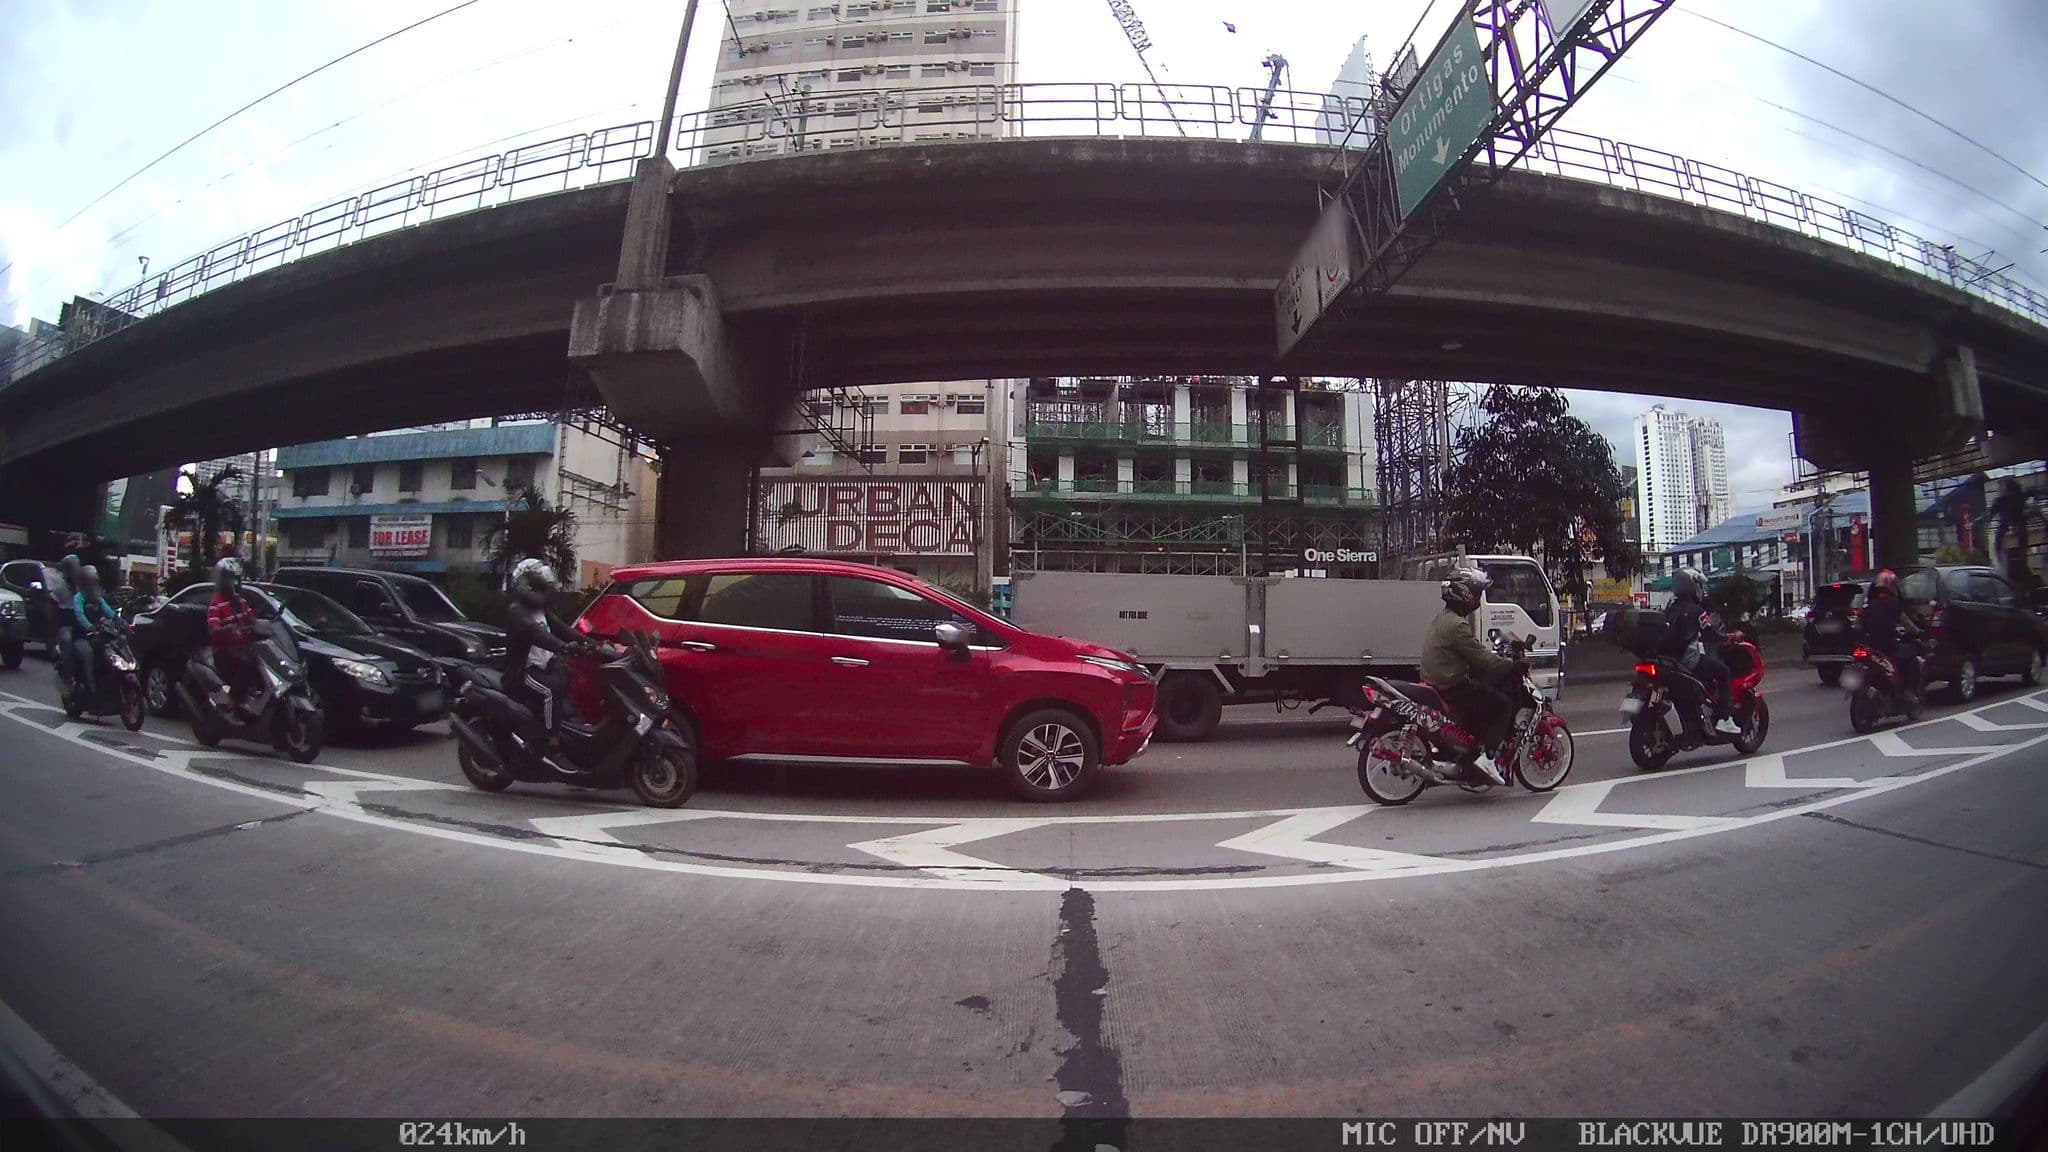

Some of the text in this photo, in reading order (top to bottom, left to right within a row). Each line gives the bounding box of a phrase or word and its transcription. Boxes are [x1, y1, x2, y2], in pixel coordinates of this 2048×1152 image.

[1400, 44, 1462, 135] Ortigas
[1398, 65, 1478, 174] Monumento
[793, 484, 977, 517] URBAN
[373, 530, 428, 545] FOR LEASE
[827, 520, 973, 551] DECA
[1305, 548, 1377, 561] One Sierra
